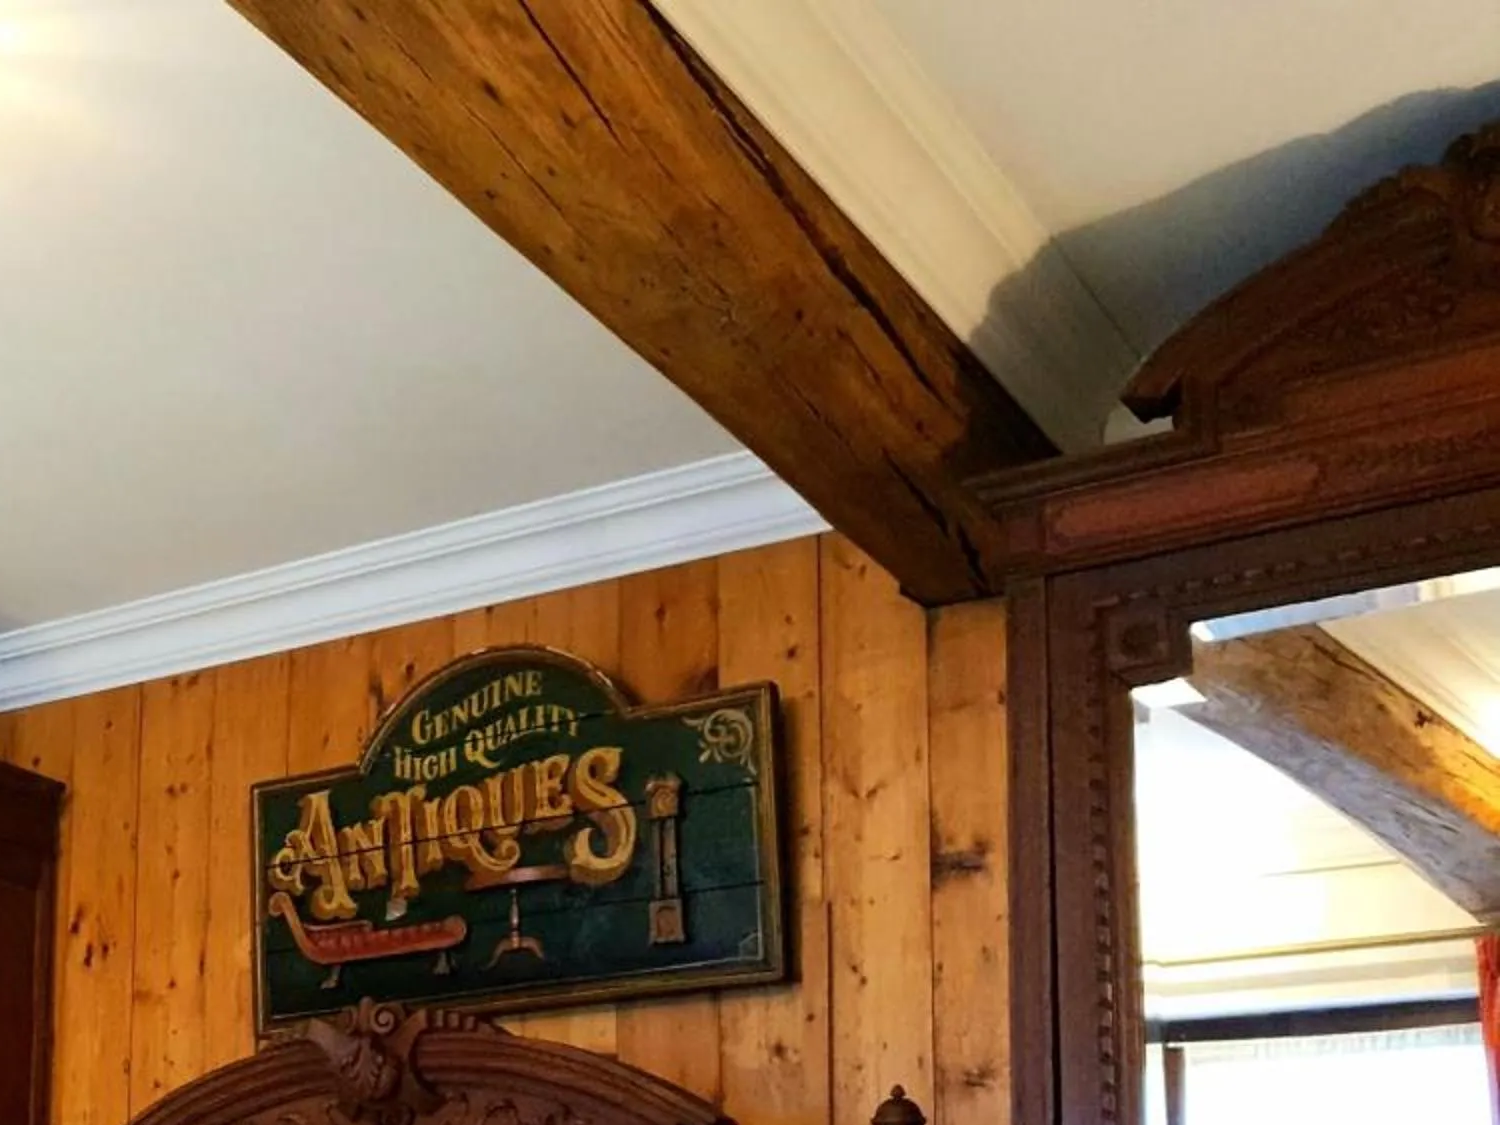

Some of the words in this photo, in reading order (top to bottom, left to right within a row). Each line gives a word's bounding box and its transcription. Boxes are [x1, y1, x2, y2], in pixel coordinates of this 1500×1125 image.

[393, 746, 457, 781] HIGH
[463, 703, 580, 769] QUALITY
[411, 670, 543, 745] GENUINE
[267, 747, 637, 920] ANTIQUES
